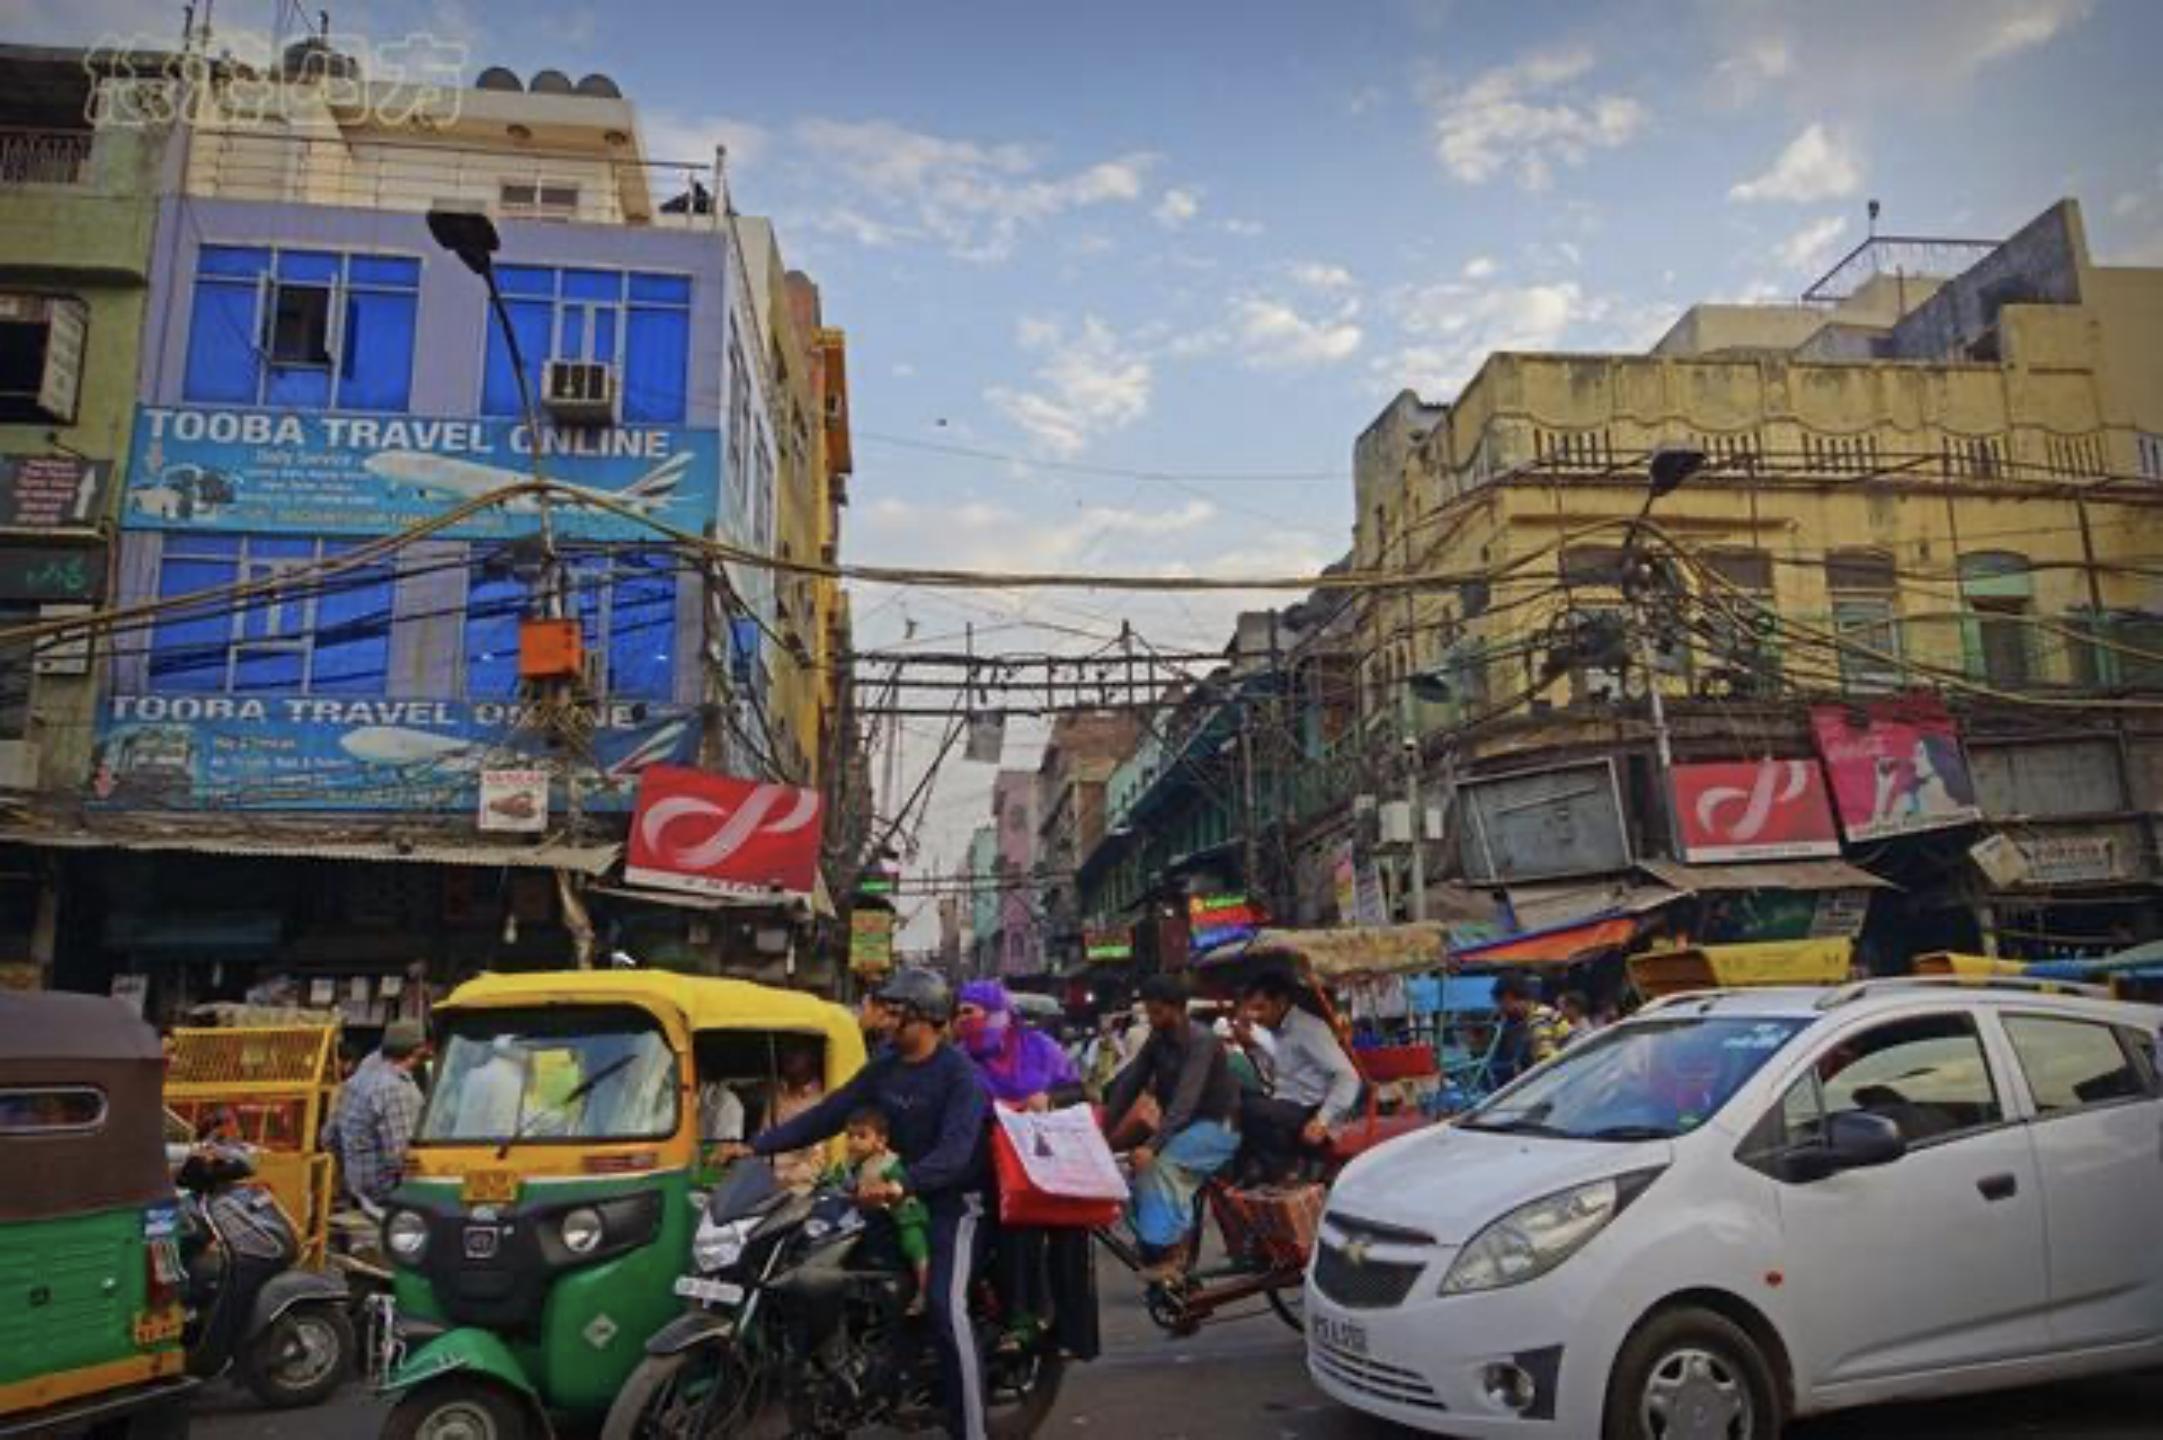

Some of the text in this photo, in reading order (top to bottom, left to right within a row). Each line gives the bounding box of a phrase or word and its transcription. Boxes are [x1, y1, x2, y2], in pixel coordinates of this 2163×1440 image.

[143, 408, 671, 458] TOOBA TRAVEL ONLINE
[282, 699, 461, 726] TRAVEL
